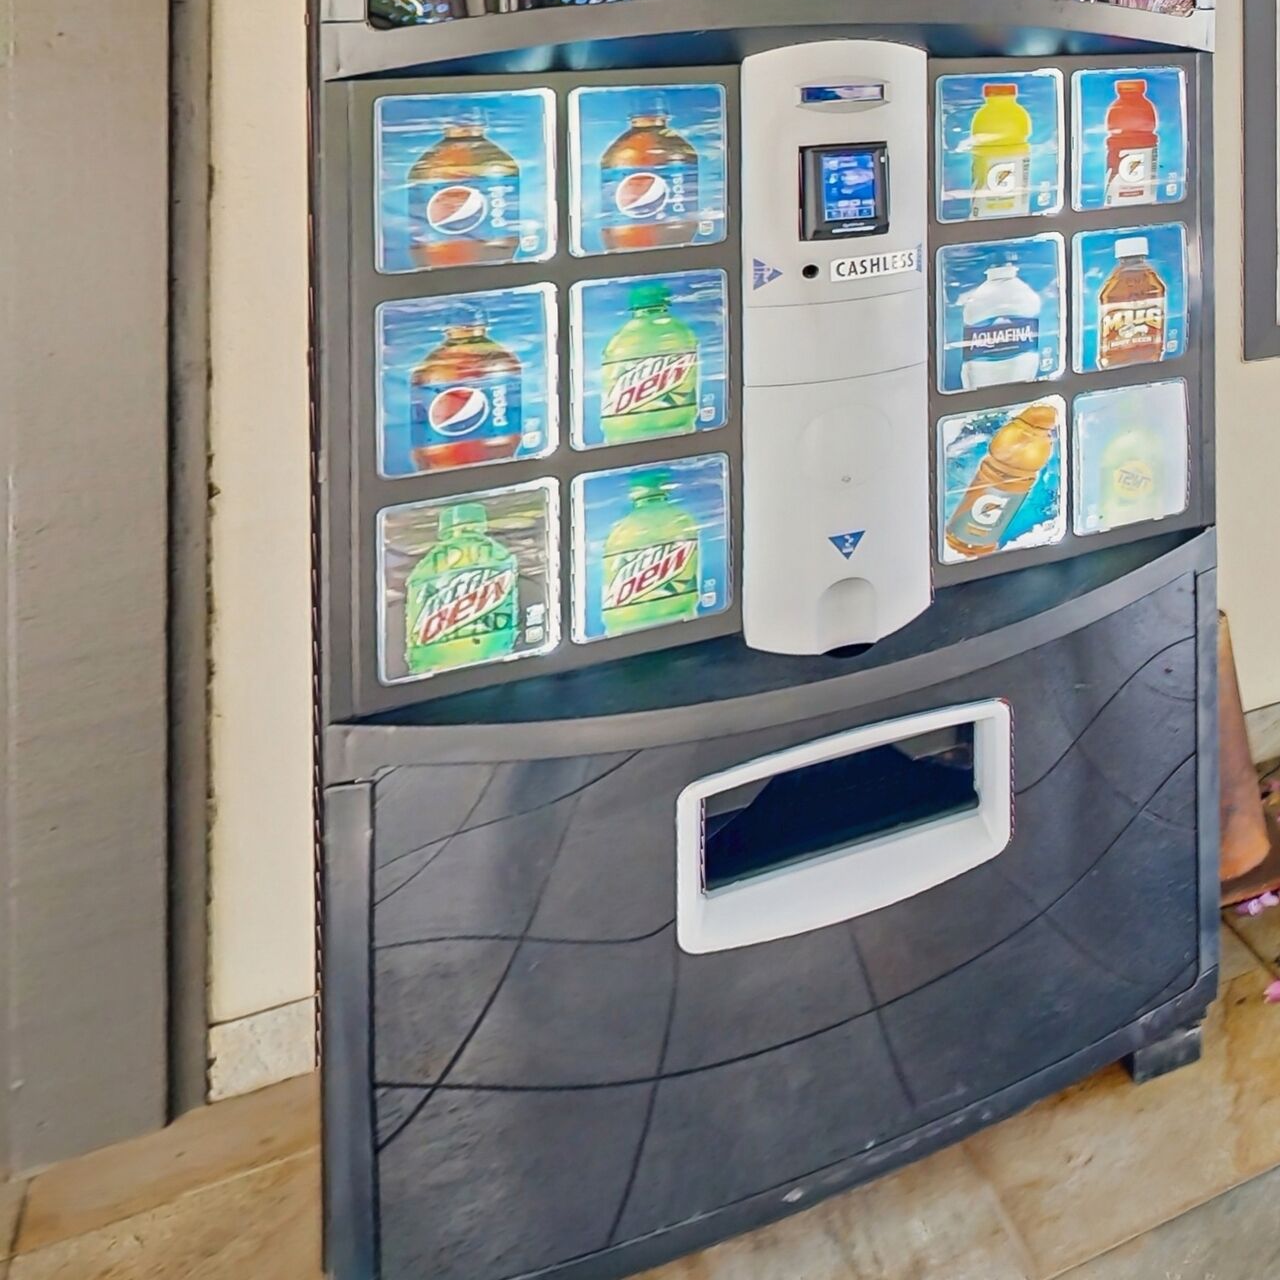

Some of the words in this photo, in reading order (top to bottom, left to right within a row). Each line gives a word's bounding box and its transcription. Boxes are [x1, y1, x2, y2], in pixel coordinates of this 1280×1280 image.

[671, 173, 685, 212] pepsi
[836, 252, 914, 277] CASHLESS
[970, 325, 1033, 351] AQUAFINA
[489, 386, 508, 427] pepsi
